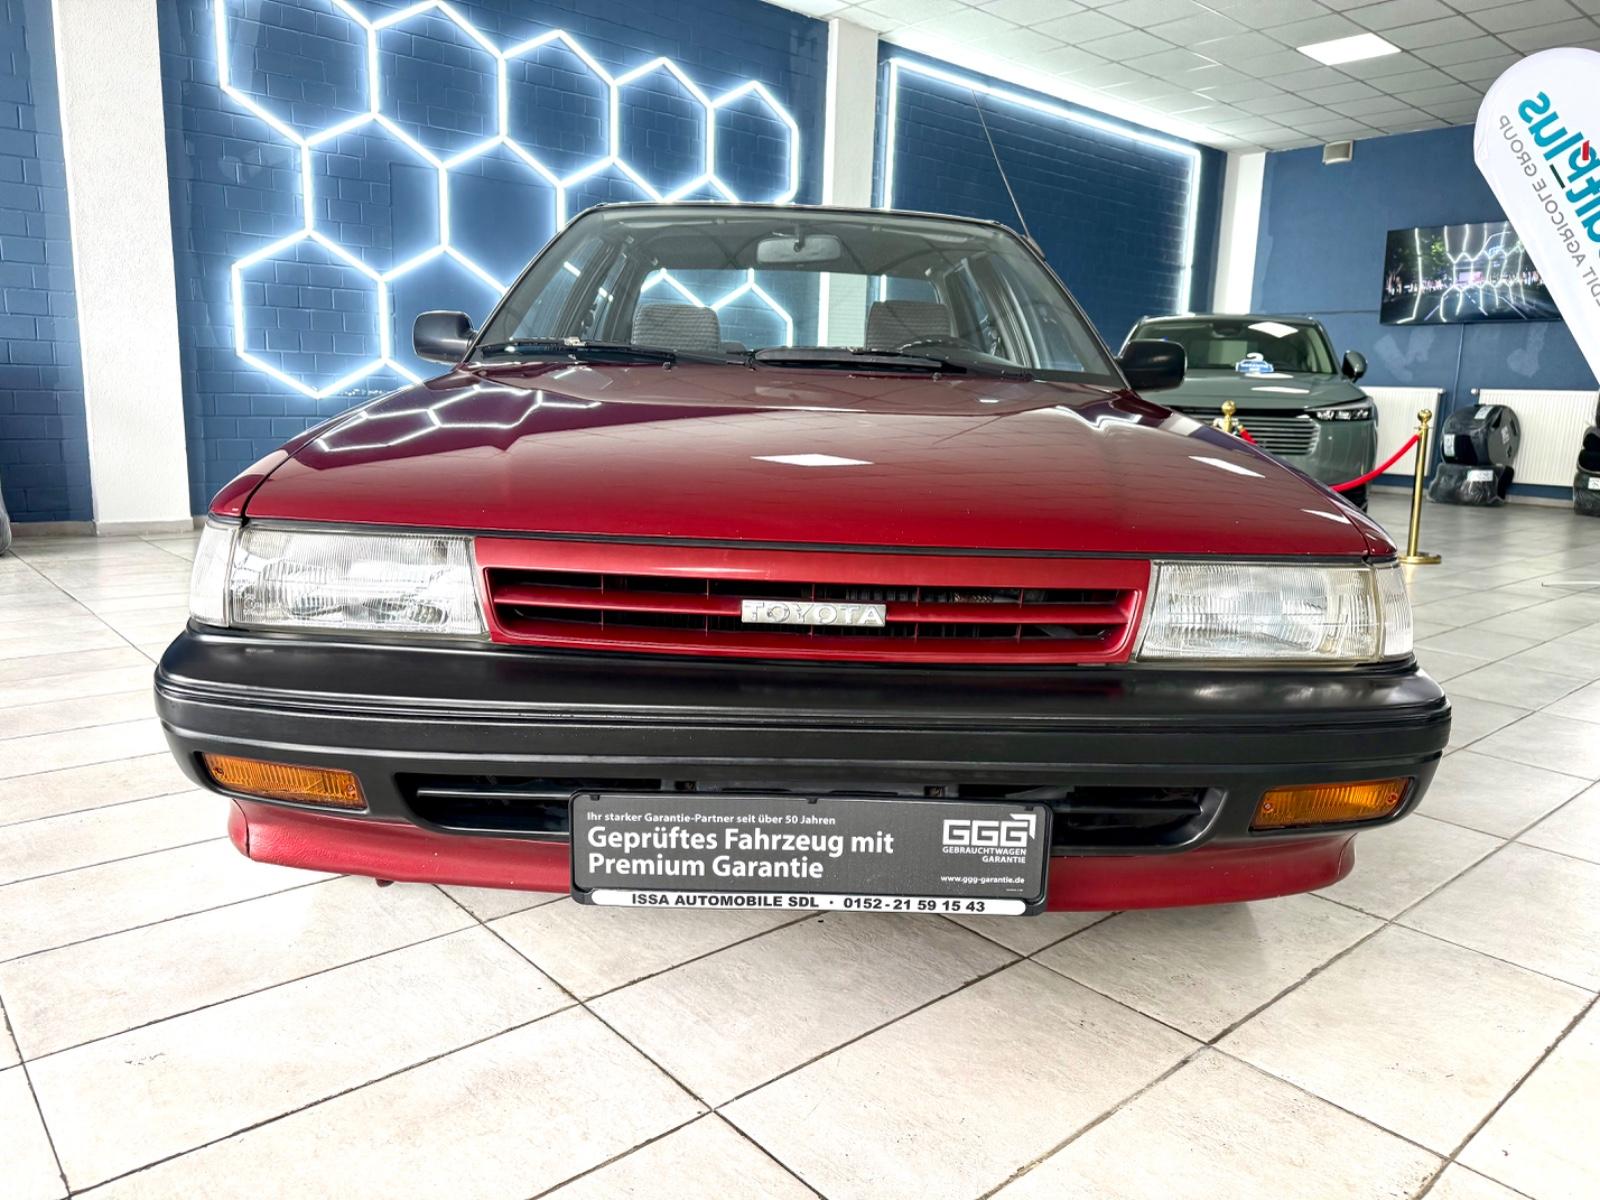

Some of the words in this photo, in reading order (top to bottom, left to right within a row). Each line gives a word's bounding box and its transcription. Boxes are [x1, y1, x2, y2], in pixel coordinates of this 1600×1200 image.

[743, 600, 885, 626] TOYOTA
[586, 811, 602, 821] Ihr
[604, 811, 642, 822] starker
[644, 812, 734, 823] Garantie-Partner
[736, 813, 756, 824] seit
[757, 813, 784, 824] über
[785, 814, 799, 824] 50
[799, 814, 836, 825] Jahren
[587, 825, 718, 853] Geprüftes
[724, 827, 844, 858] Fahrzeug
[850, 830, 895, 854] mit
[942, 818, 1030, 848] GGG
[941, 845, 1027, 856] GEBRAUCHTWAGEN
[981, 854, 1026, 864] GARANTIE
[588, 852, 705, 876] Premium
[711, 854, 824, 878] Garantie
[940, 875, 1025, 885] www.ggg-garantie.de
[632, 893, 670, 905] ISSA
[675, 895, 783, 907] AUTOMOBILE
[788, 896, 819, 907] SDL
[917, 899, 937, 911] 59
[942, 900, 961, 912] 15
[965, 901, 985, 913] 43
